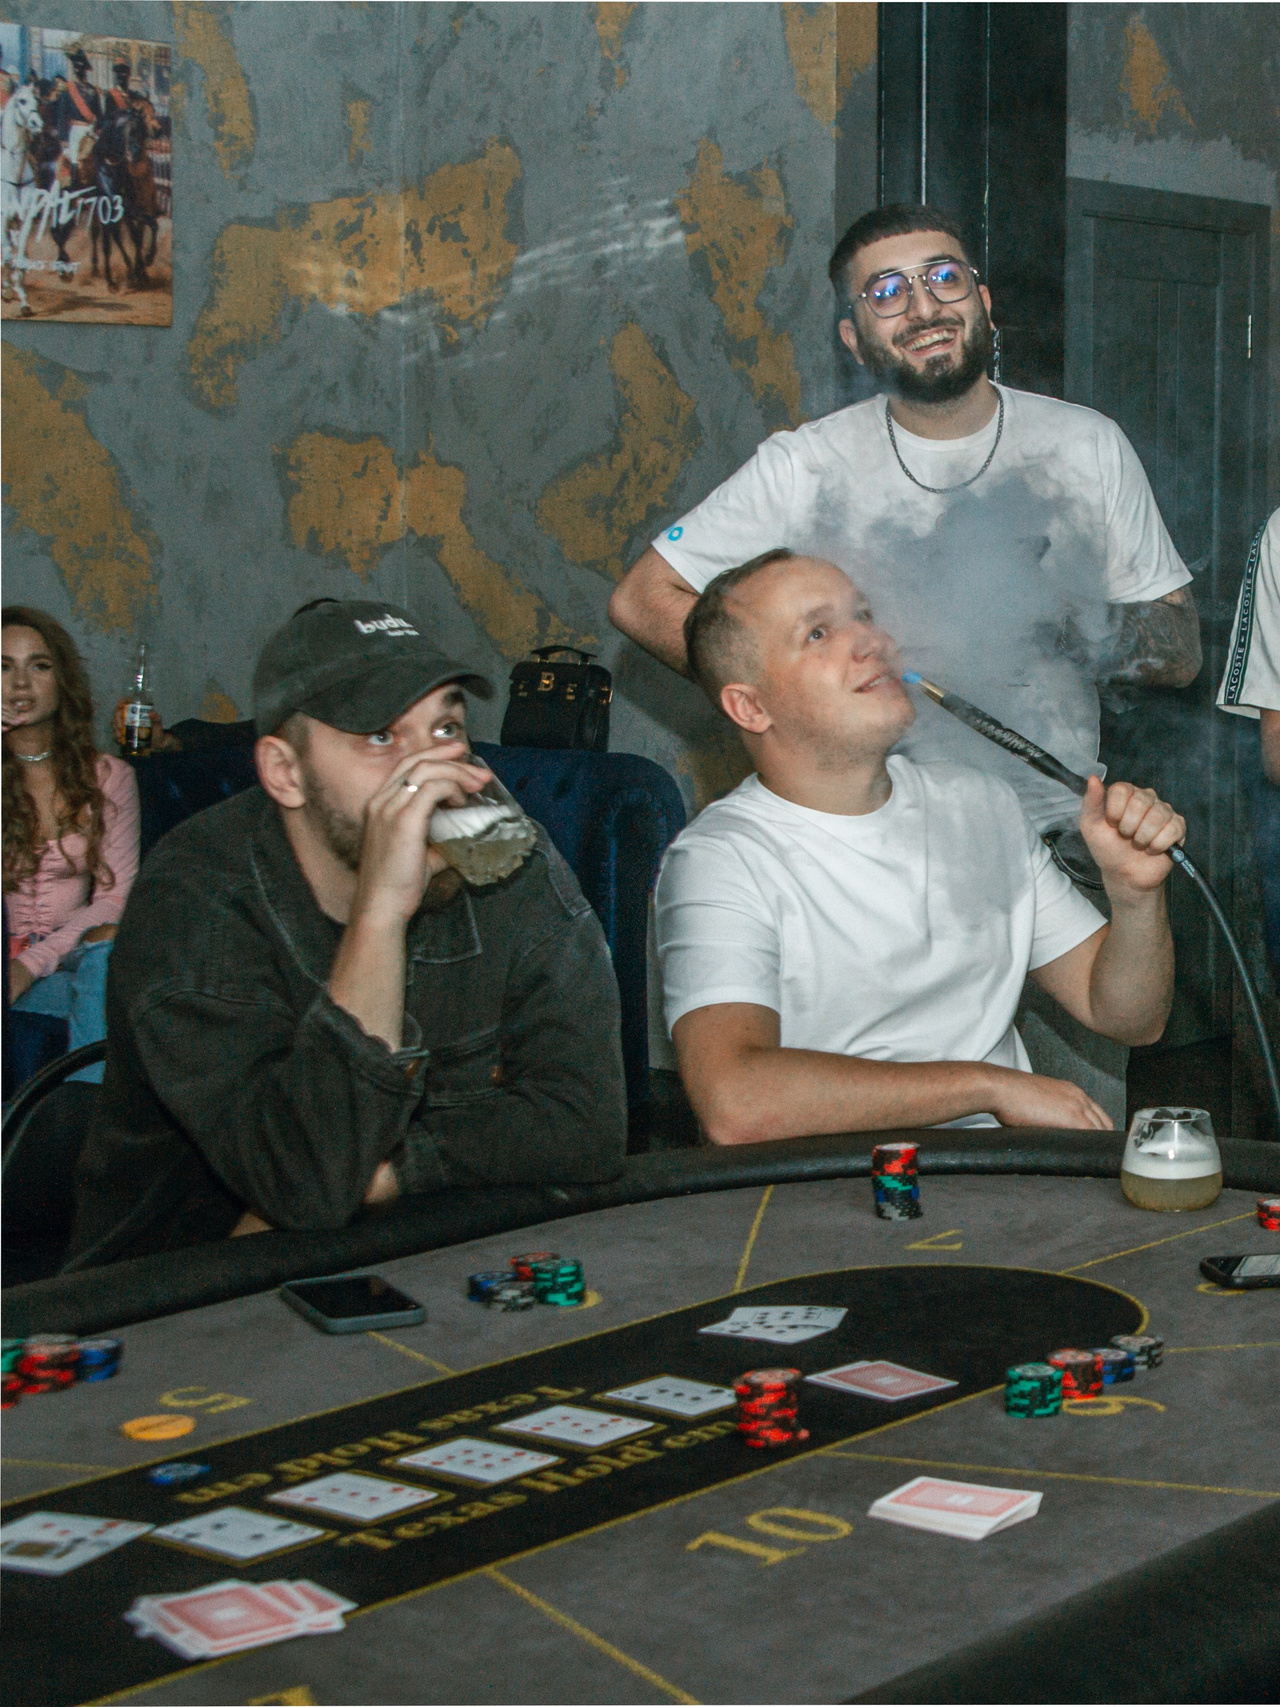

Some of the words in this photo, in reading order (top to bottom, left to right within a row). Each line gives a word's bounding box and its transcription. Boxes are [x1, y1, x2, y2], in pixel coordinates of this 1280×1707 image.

[1228, 647, 1245, 699] LACOSTE
[1241, 578, 1252, 631] LACOSTE
[417, 1386, 587, 1431] Texas
[335, 1491, 528, 1549] Texas
[686, 1507, 854, 1568] 10
